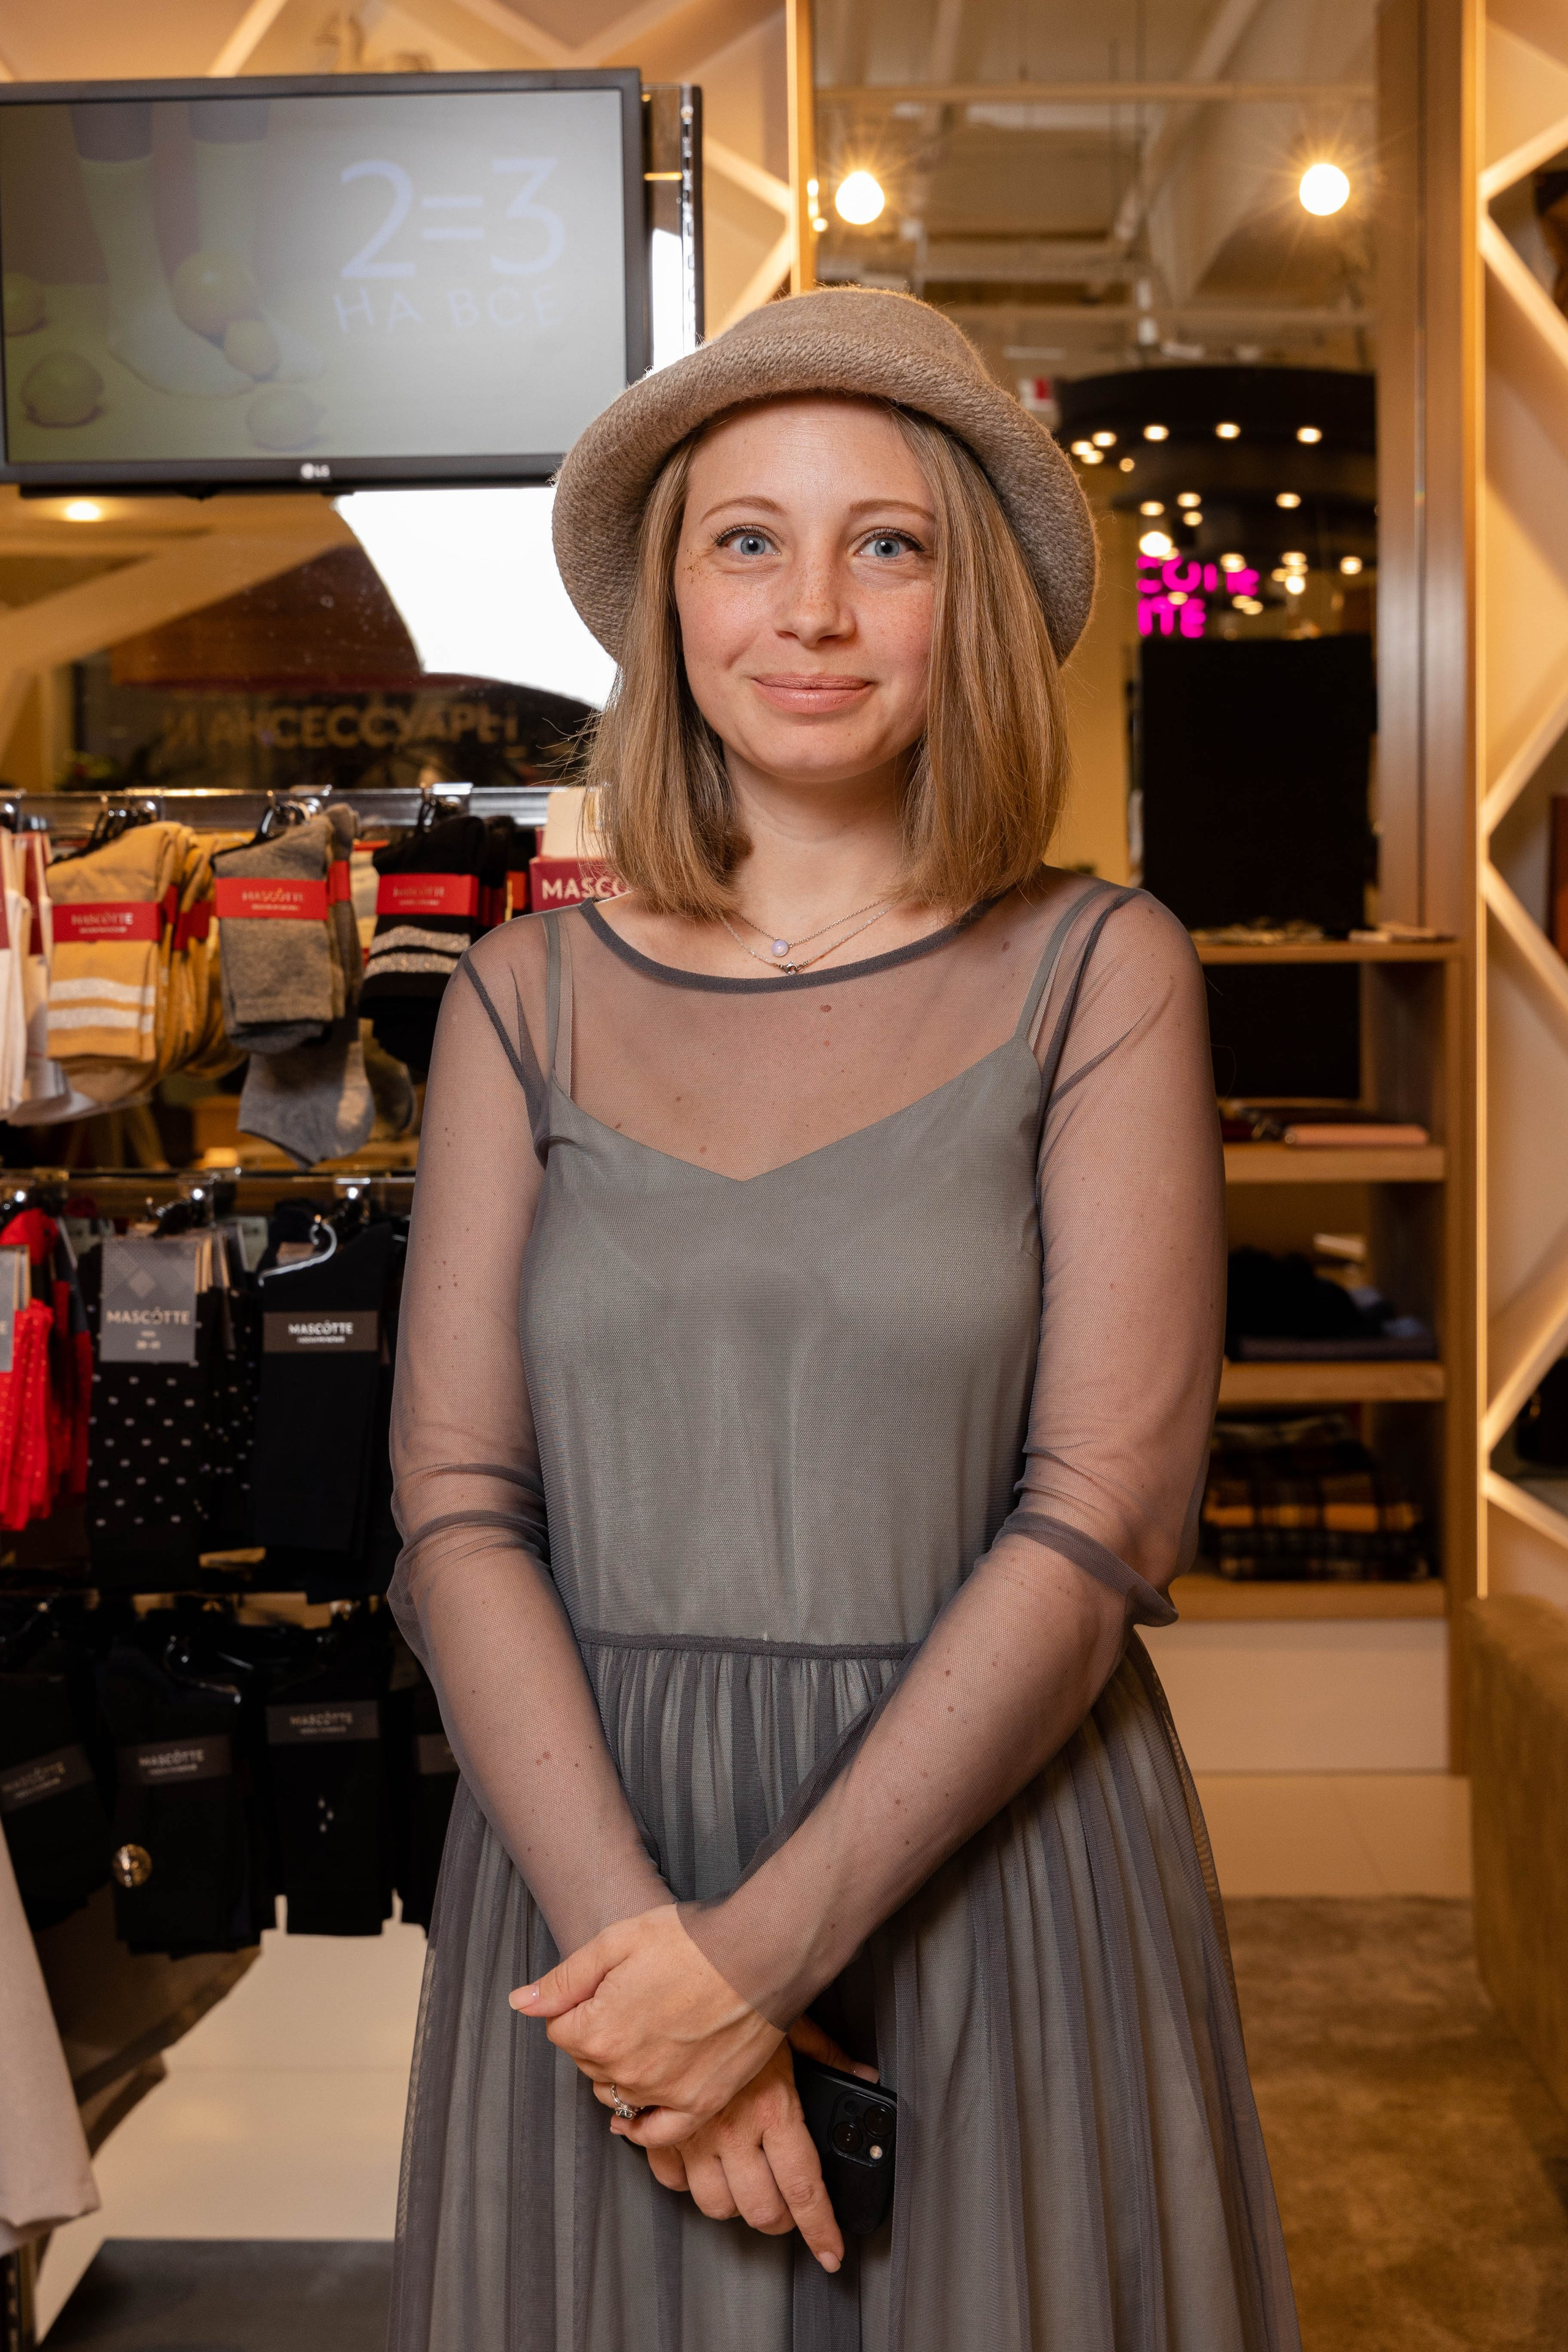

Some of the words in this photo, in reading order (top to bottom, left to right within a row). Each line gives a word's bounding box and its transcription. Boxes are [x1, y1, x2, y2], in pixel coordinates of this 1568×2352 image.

[341, 157, 565, 279] 2=3
[333, 285, 423, 334] НА
[447, 284, 562, 328] ВСЕ
